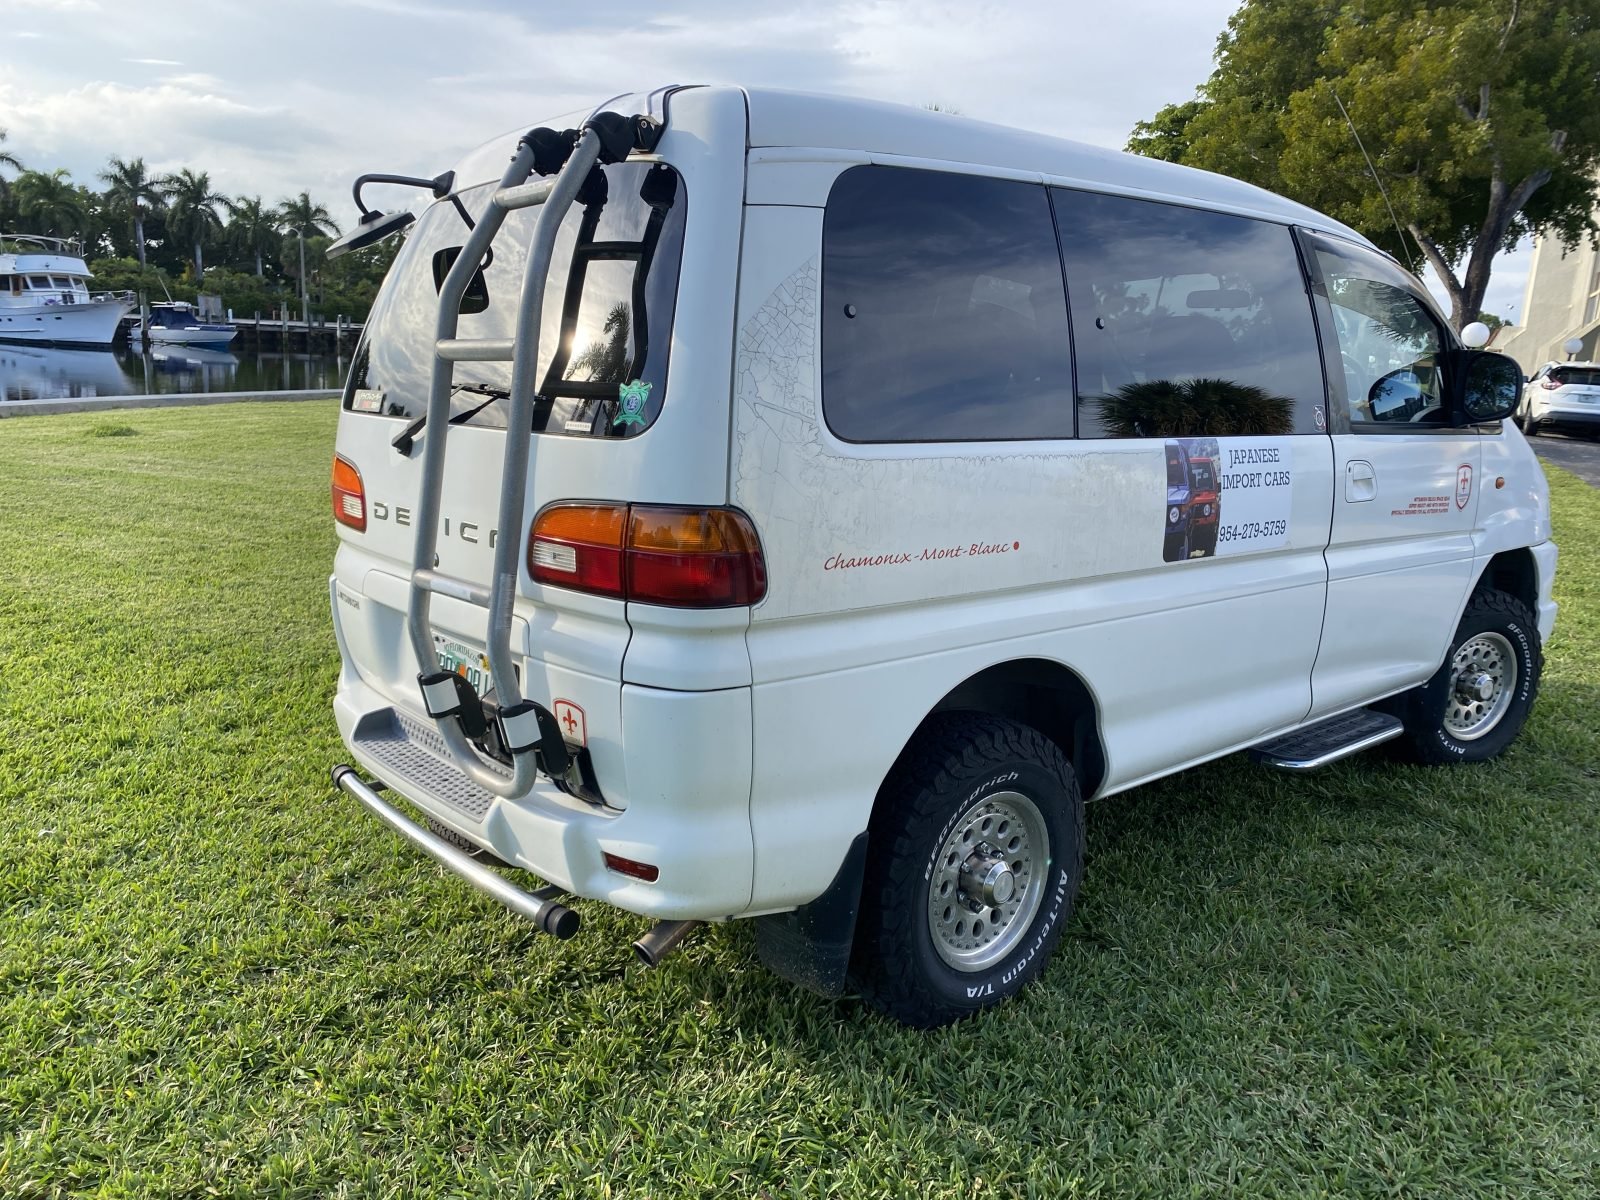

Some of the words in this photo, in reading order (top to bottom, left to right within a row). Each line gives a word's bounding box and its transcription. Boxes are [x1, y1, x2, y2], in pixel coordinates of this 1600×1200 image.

[1229, 448, 1280, 468] JAPANESE
[1222, 472, 1262, 490] IMPORT
[1264, 471, 1290, 486] CARS
[373, 502, 499, 548] DEIC
[1219, 519, 1287, 542] 954-279-5759
[1002, 869, 1068, 985] All-Terrain
[966, 985, 995, 999] T/A
